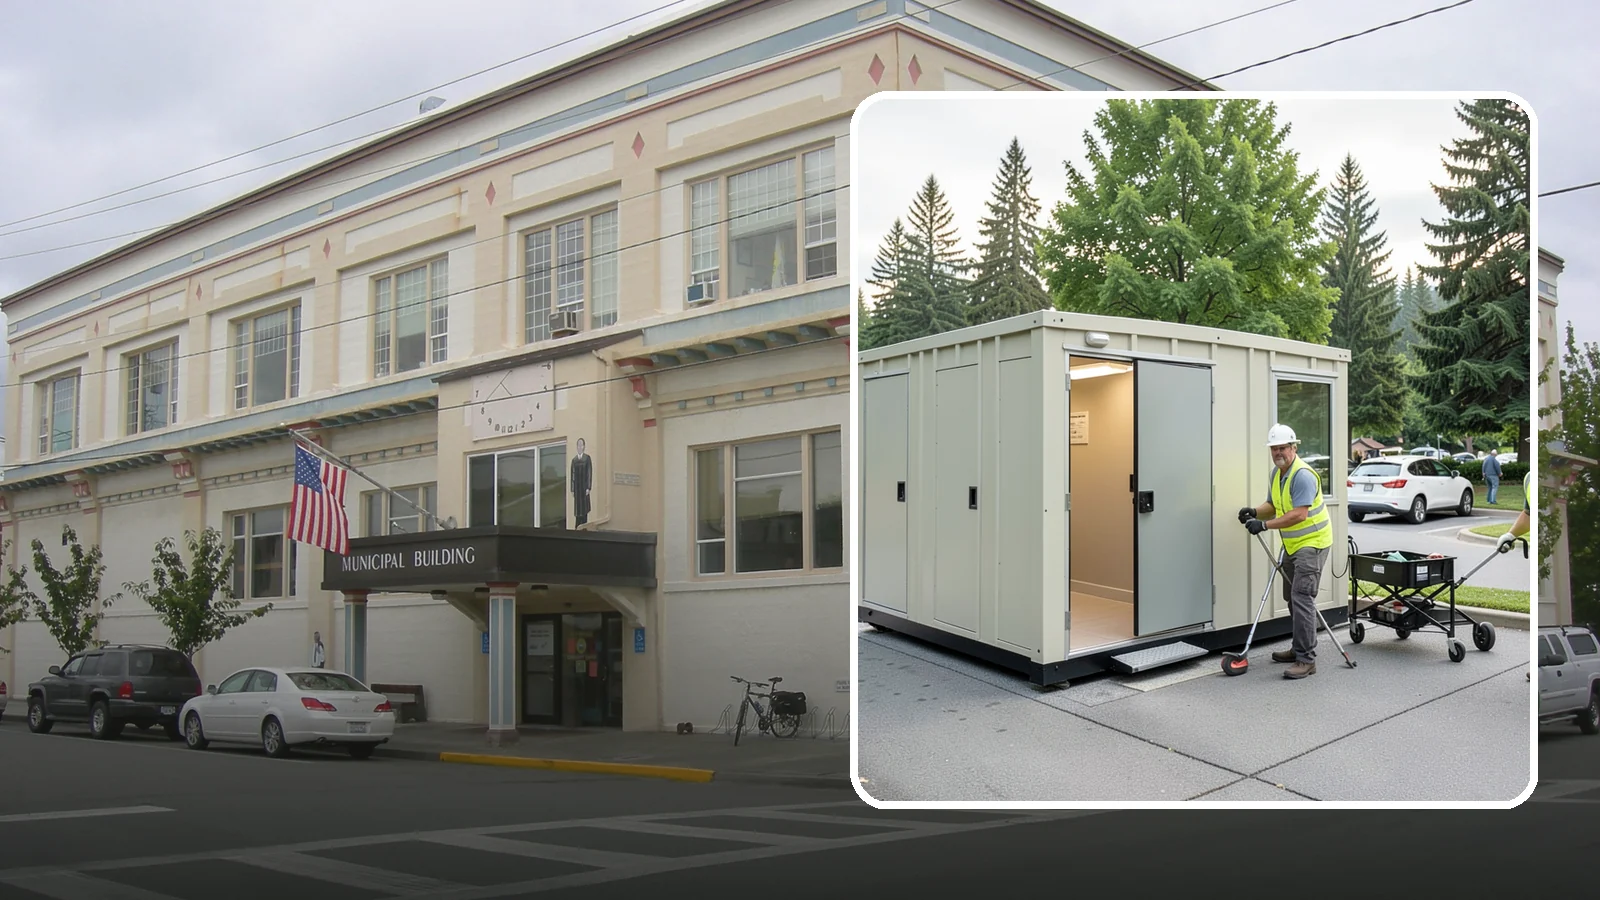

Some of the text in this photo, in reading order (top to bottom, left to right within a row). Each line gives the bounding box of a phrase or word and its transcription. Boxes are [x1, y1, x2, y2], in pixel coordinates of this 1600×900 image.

[547, 362, 551, 370] 6
[536, 402, 540, 410] 4
[480, 407, 485, 415] 8
[487, 417, 492, 426] 9
[494, 424, 500, 432] 10
[507, 425, 514, 434] 12
[520, 420, 526, 428] 2
[529, 414, 533, 422] 3
[342, 546, 475, 572] MUNICIPAL BUILDING
